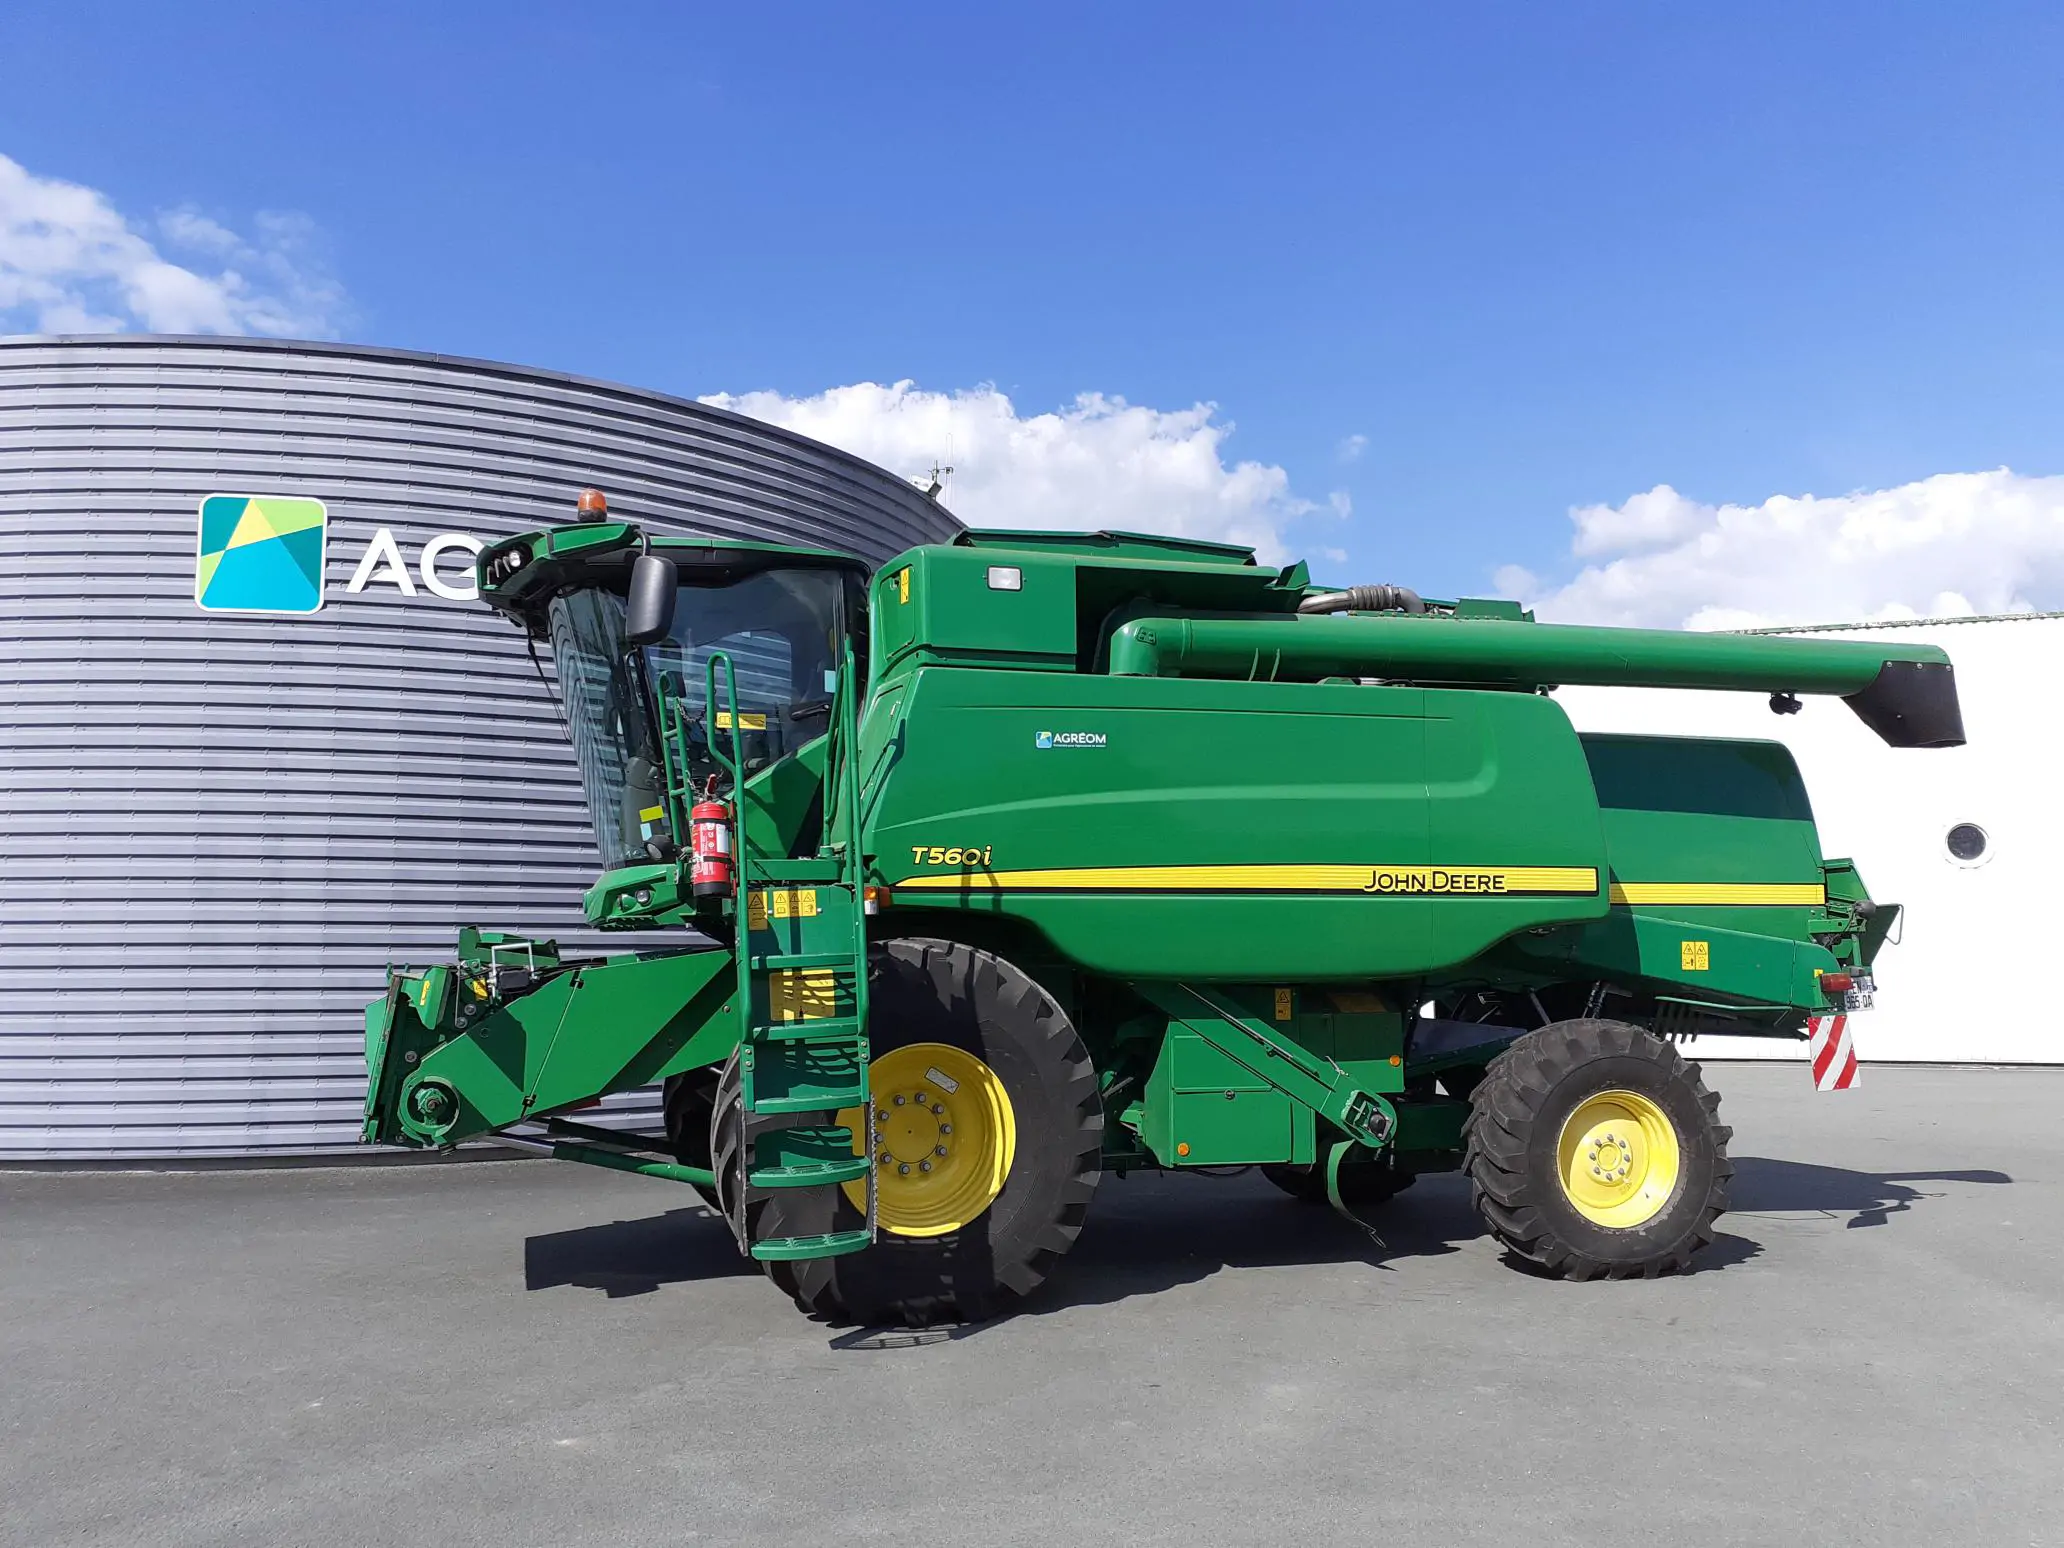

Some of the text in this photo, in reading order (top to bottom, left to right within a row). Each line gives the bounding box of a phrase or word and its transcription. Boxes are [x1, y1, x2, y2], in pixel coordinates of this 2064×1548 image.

[1053, 732, 1106, 744] AGRÉOM
[911, 845, 992, 866] T560i
[1364, 870, 1505, 890] JOHN DEERE
